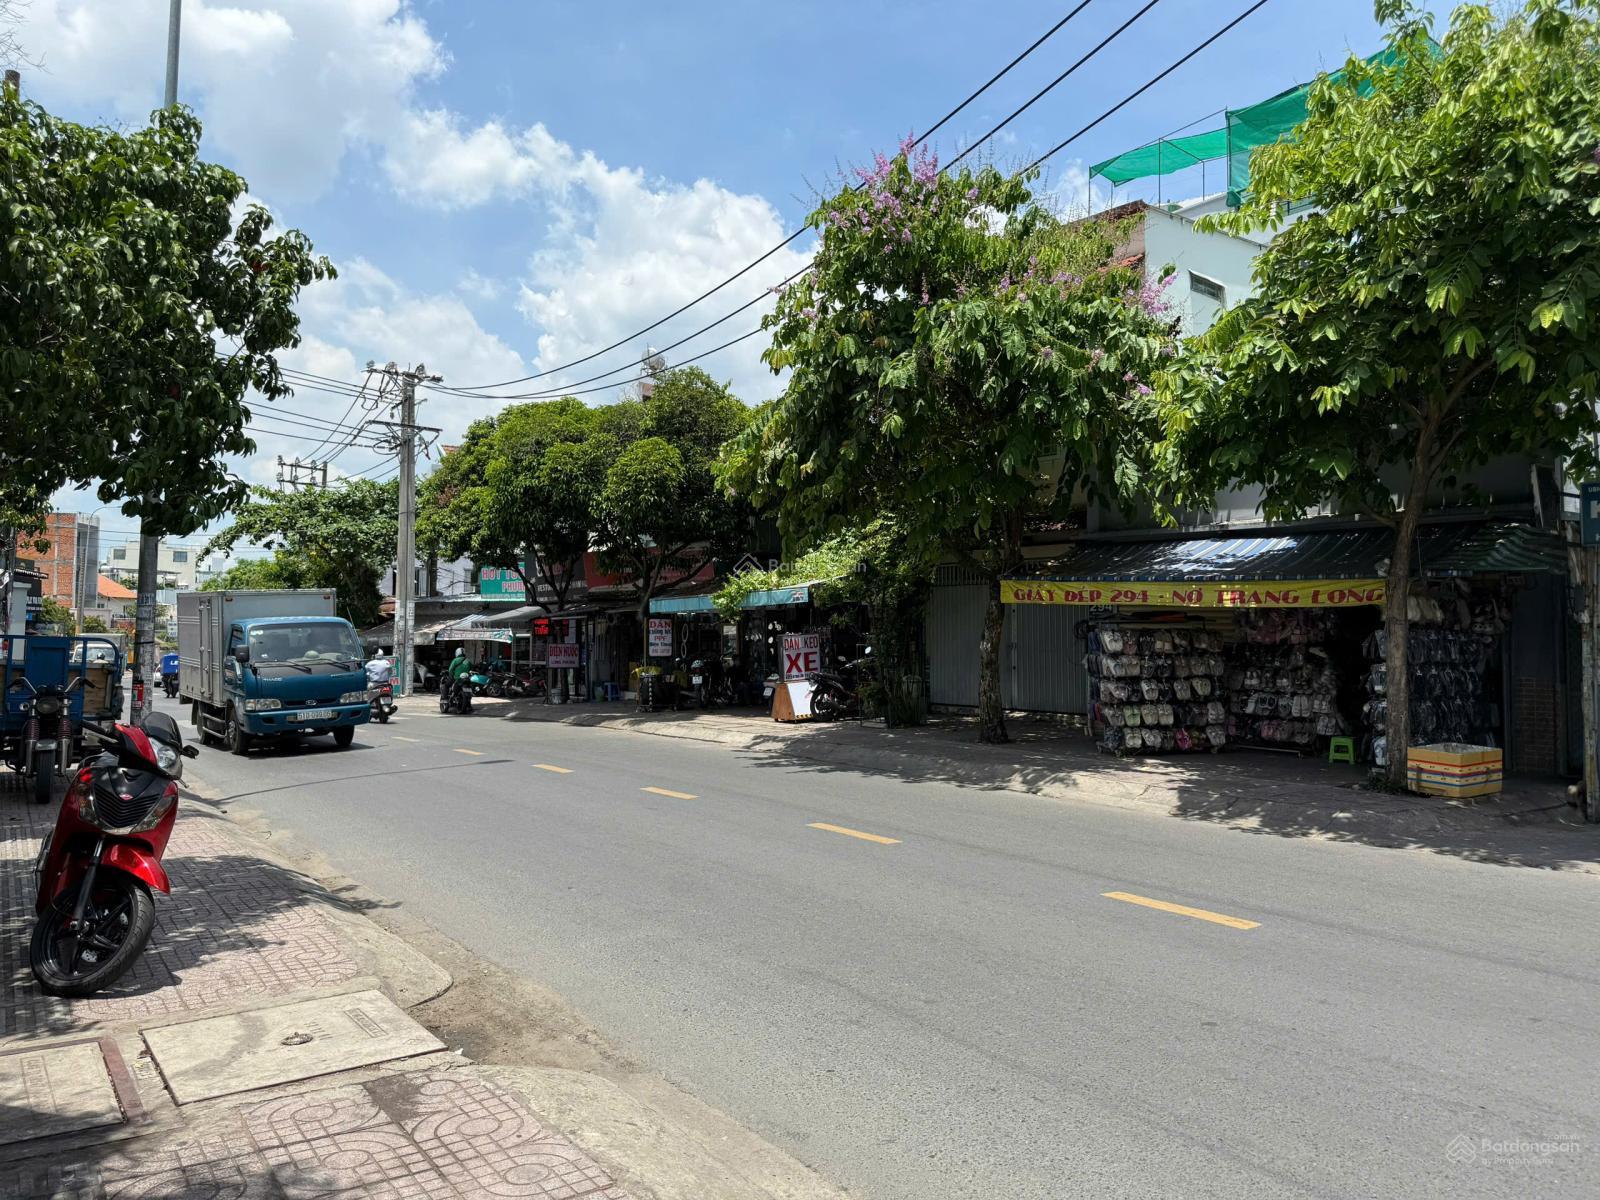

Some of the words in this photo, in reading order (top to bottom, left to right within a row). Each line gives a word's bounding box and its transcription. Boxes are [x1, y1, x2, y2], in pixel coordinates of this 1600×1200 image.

[1110, 589, 1149, 603] 294
[1215, 589, 1299, 604] TRANG
[1312, 588, 1383, 604] LONG
[786, 651, 818, 673] XE
